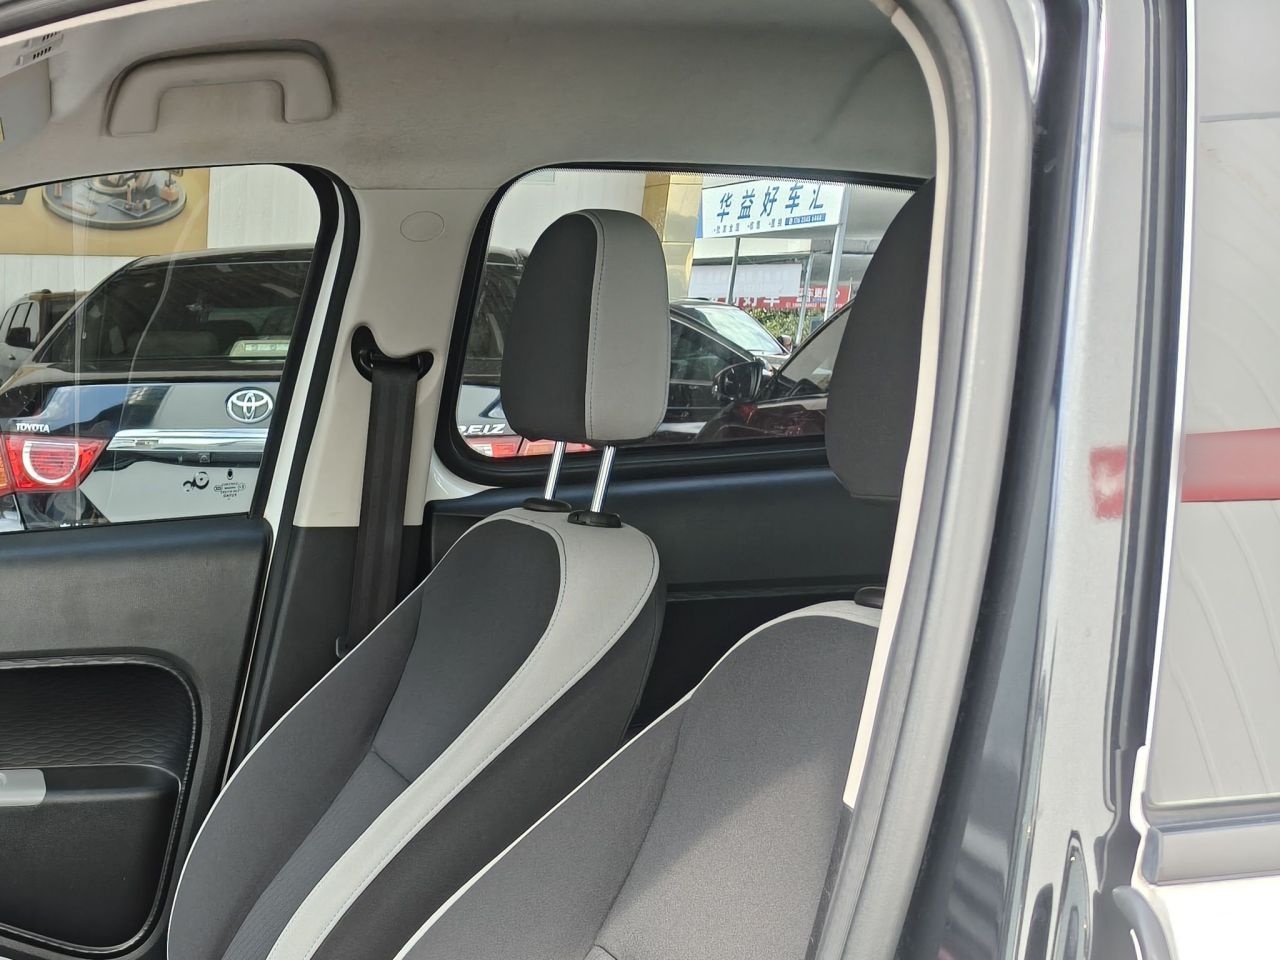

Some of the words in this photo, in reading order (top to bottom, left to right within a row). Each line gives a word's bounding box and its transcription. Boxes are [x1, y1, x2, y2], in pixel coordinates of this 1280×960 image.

[716, 181, 824, 223] 华益好车汇
[15, 422, 50, 434] TOYOTA
